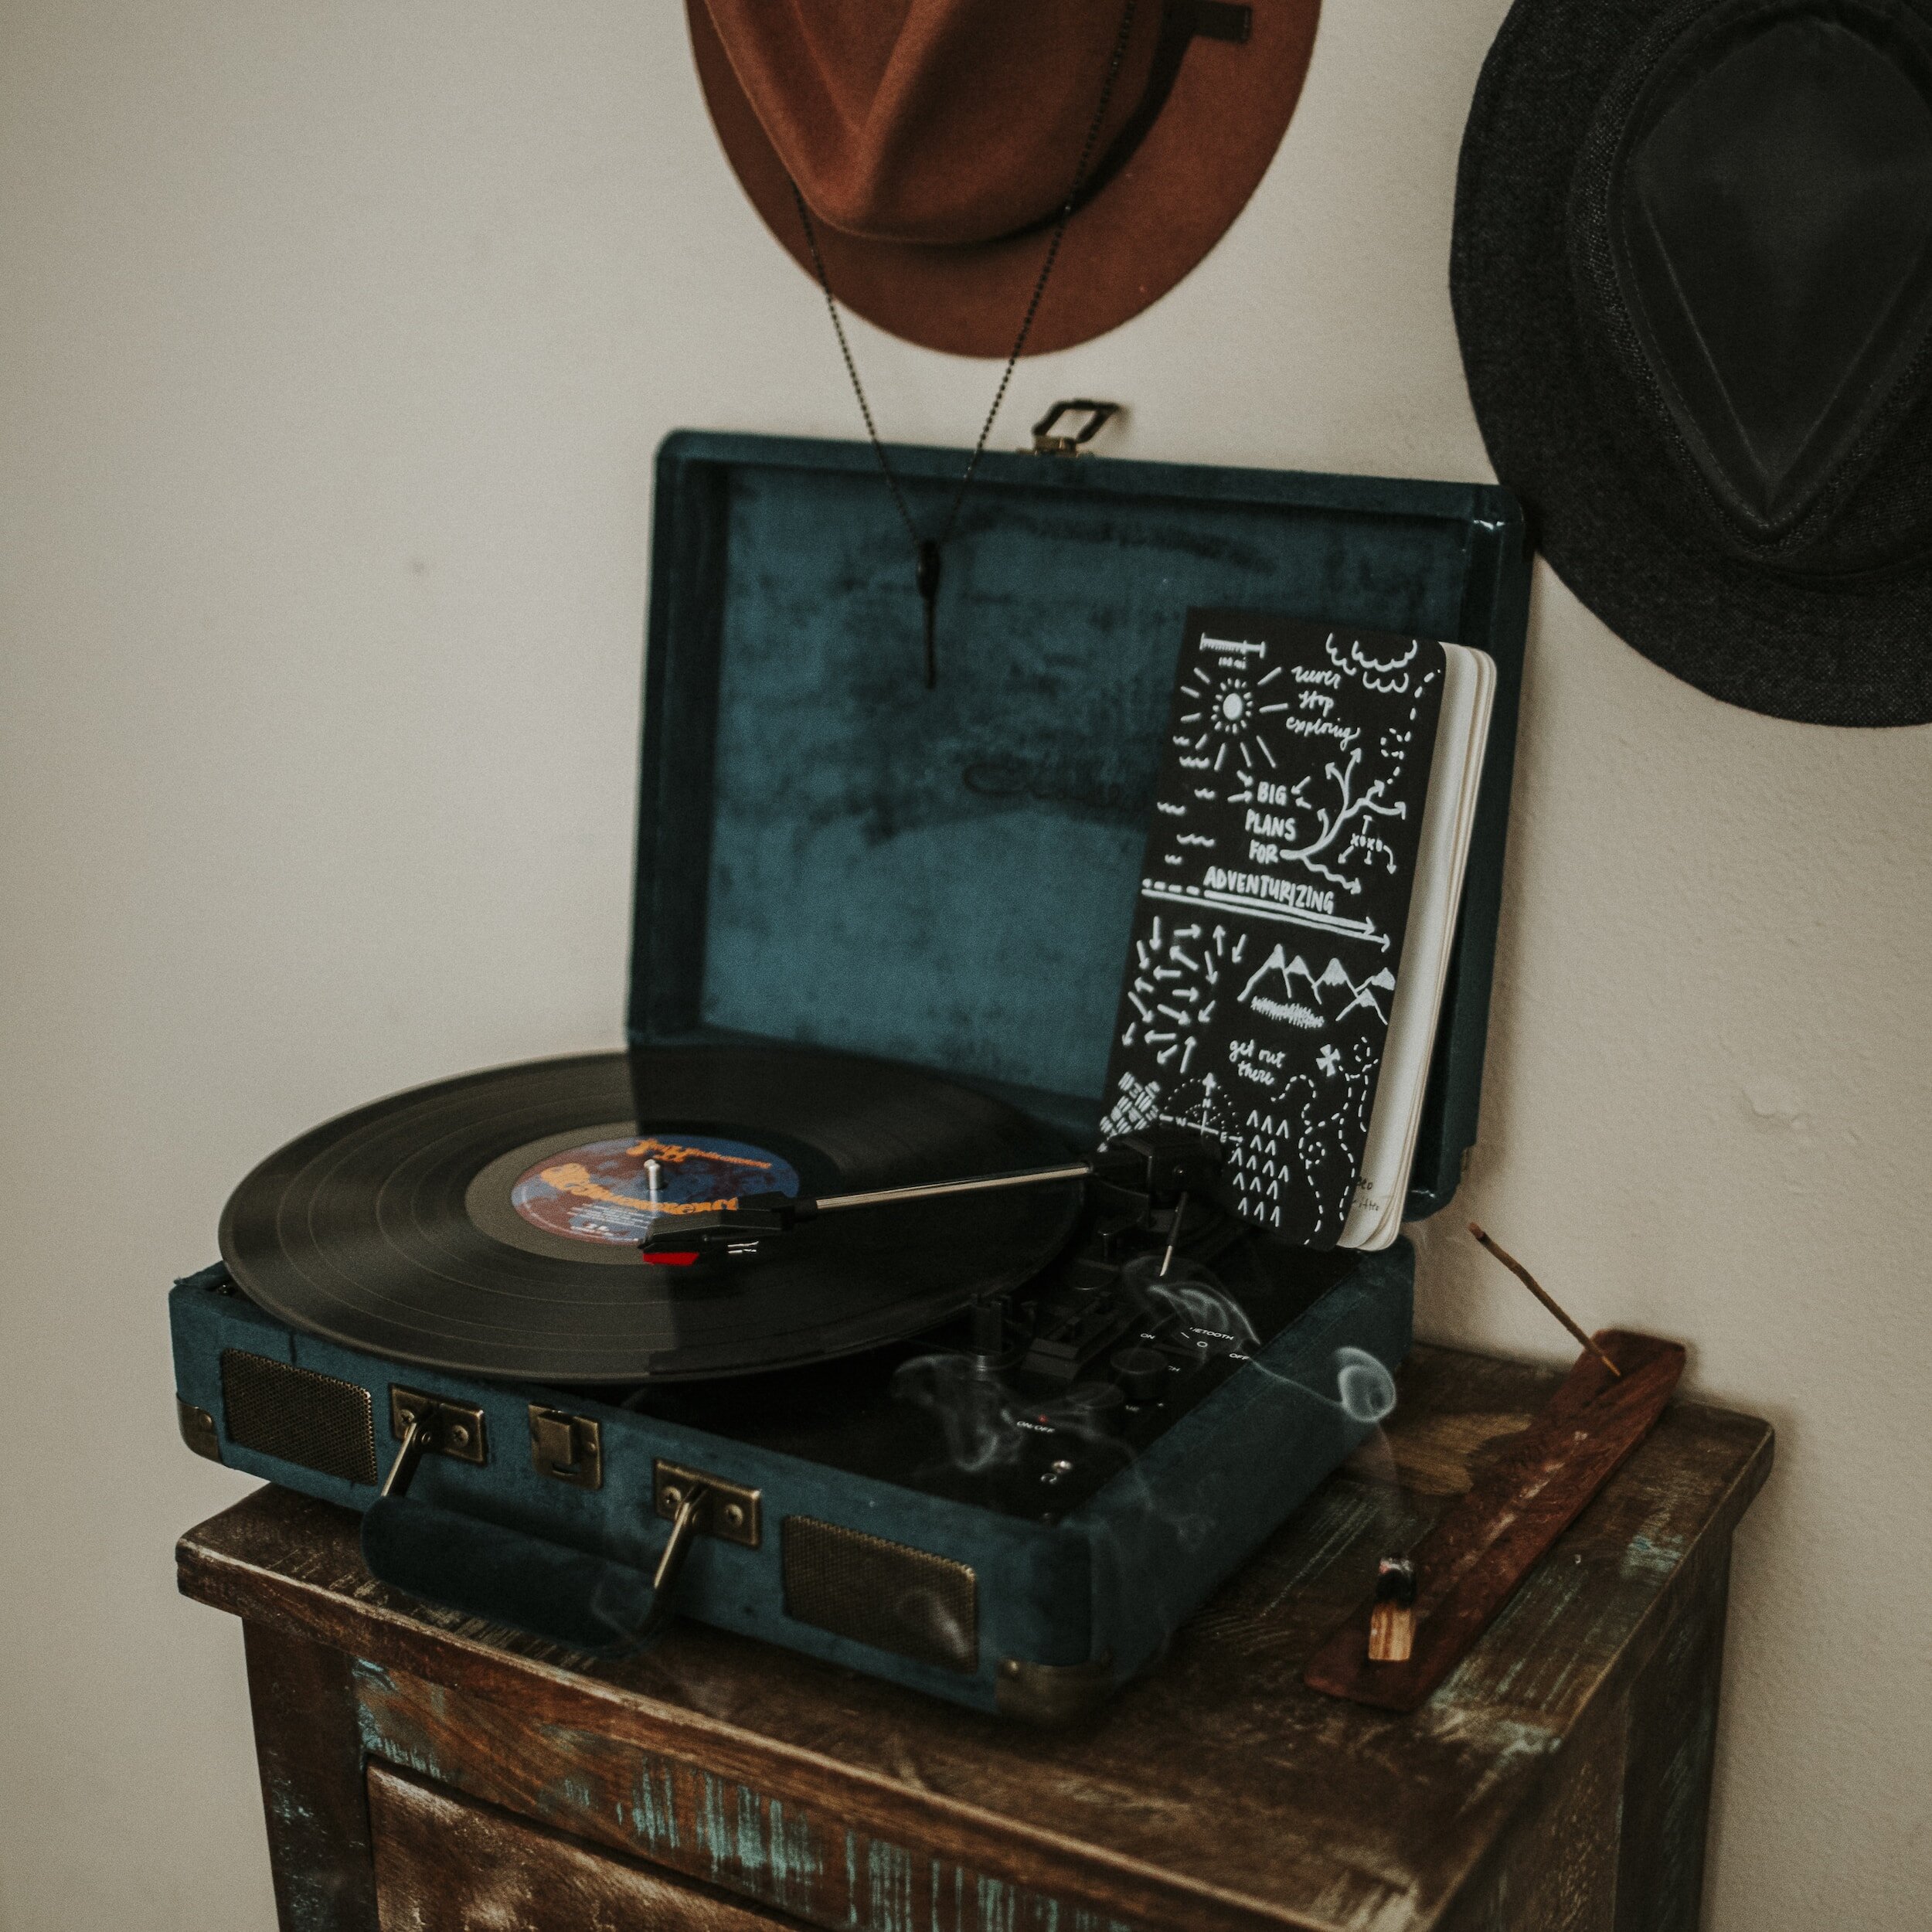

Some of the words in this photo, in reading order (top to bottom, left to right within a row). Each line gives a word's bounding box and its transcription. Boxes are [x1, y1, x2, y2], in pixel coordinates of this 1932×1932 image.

[1298, 690, 1335, 717] stop
[1285, 716, 1361, 751] exploring
[1257, 781, 1287, 806] BIG
[1244, 808, 1297, 842] PLANS
[1248, 839, 1279, 864] FOR
[1202, 866, 1335, 915] ADVENTURIZING
[1229, 1039, 1255, 1063] get
[1258, 1049, 1286, 1069] out
[1238, 1060, 1275, 1086] there
[1229, 1352, 1250, 1361] OFF
